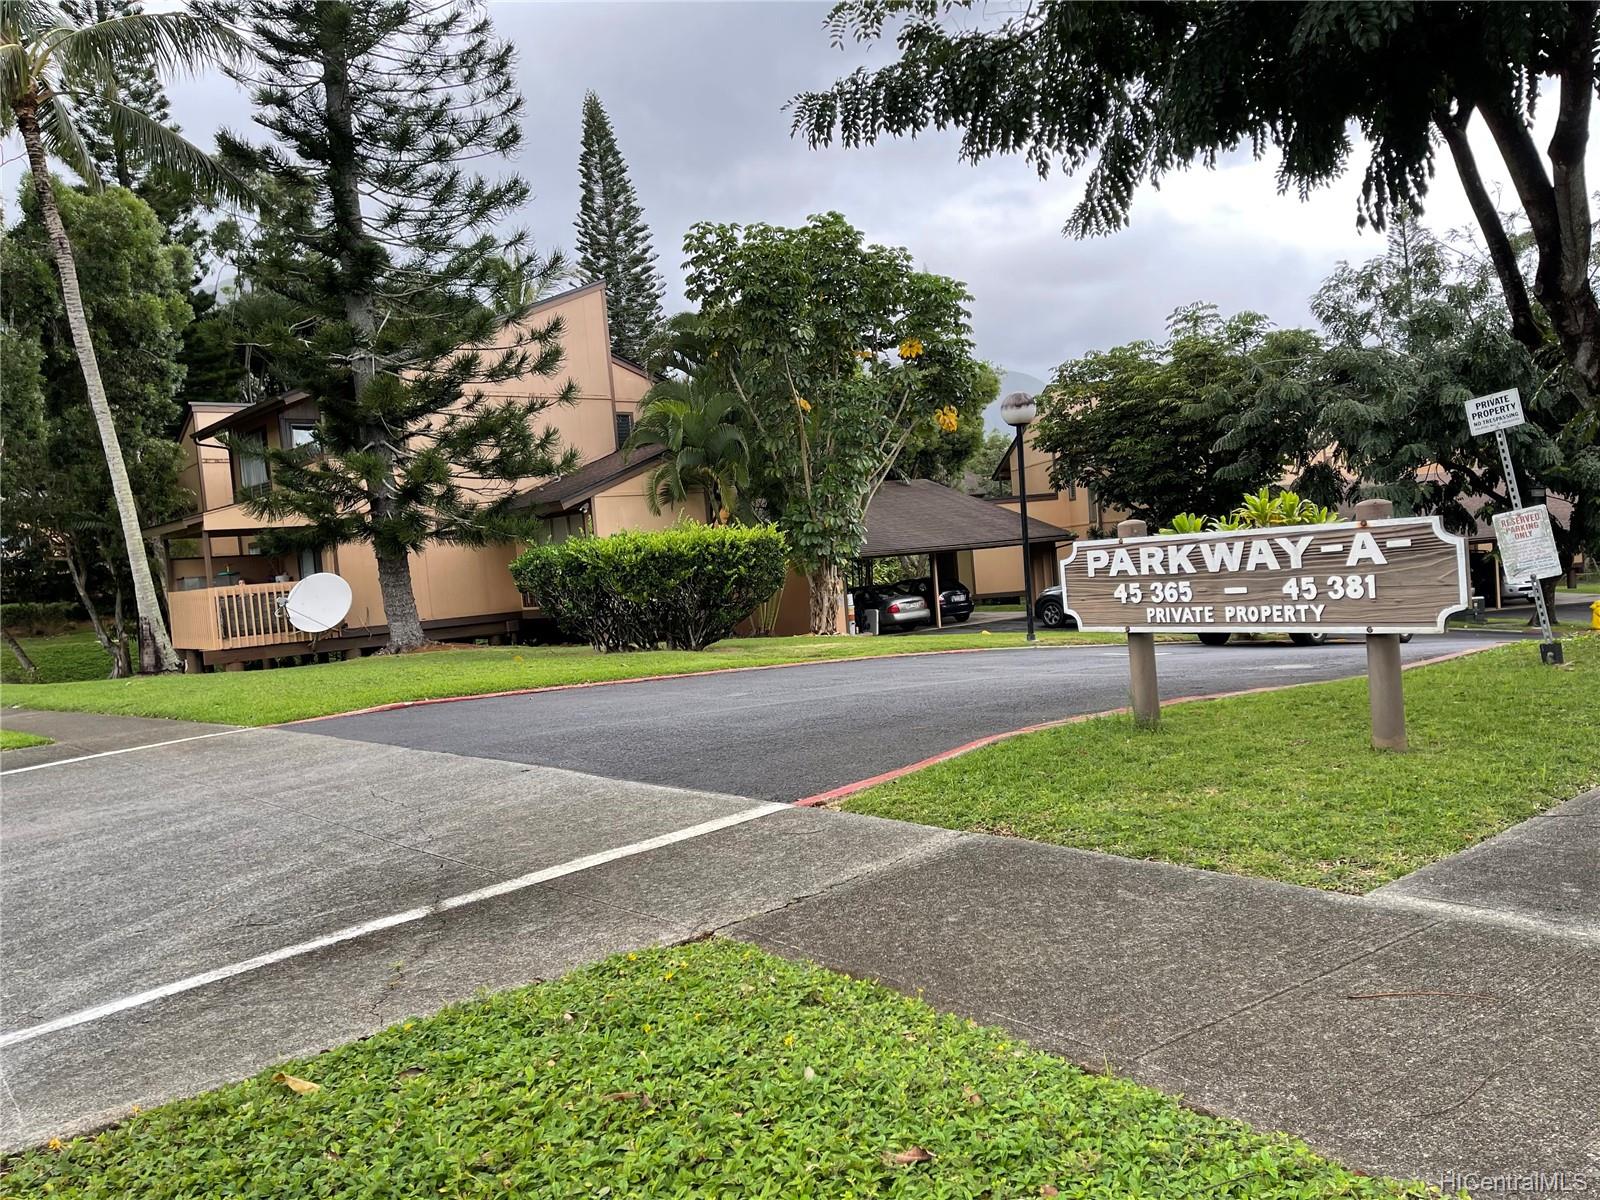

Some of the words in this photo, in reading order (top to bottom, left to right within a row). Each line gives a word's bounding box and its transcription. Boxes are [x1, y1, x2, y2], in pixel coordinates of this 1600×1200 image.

[1475, 395, 1509, 410] PRIVATE
[1471, 402, 1517, 421] PROPERTY
[1501, 513, 1540, 527] RESERVED
[1506, 522, 1539, 533] PARKING
[1514, 530, 1533, 540] ONLY
[1114, 583, 1142, 604] 45
[1150, 581, 1193, 603] 365
[1282, 577, 1317, 601] 45
[1327, 574, 1376, 600] 381
[1146, 606, 1215, 624] PRIVATE
[1225, 604, 1326, 623] PROPERTY
